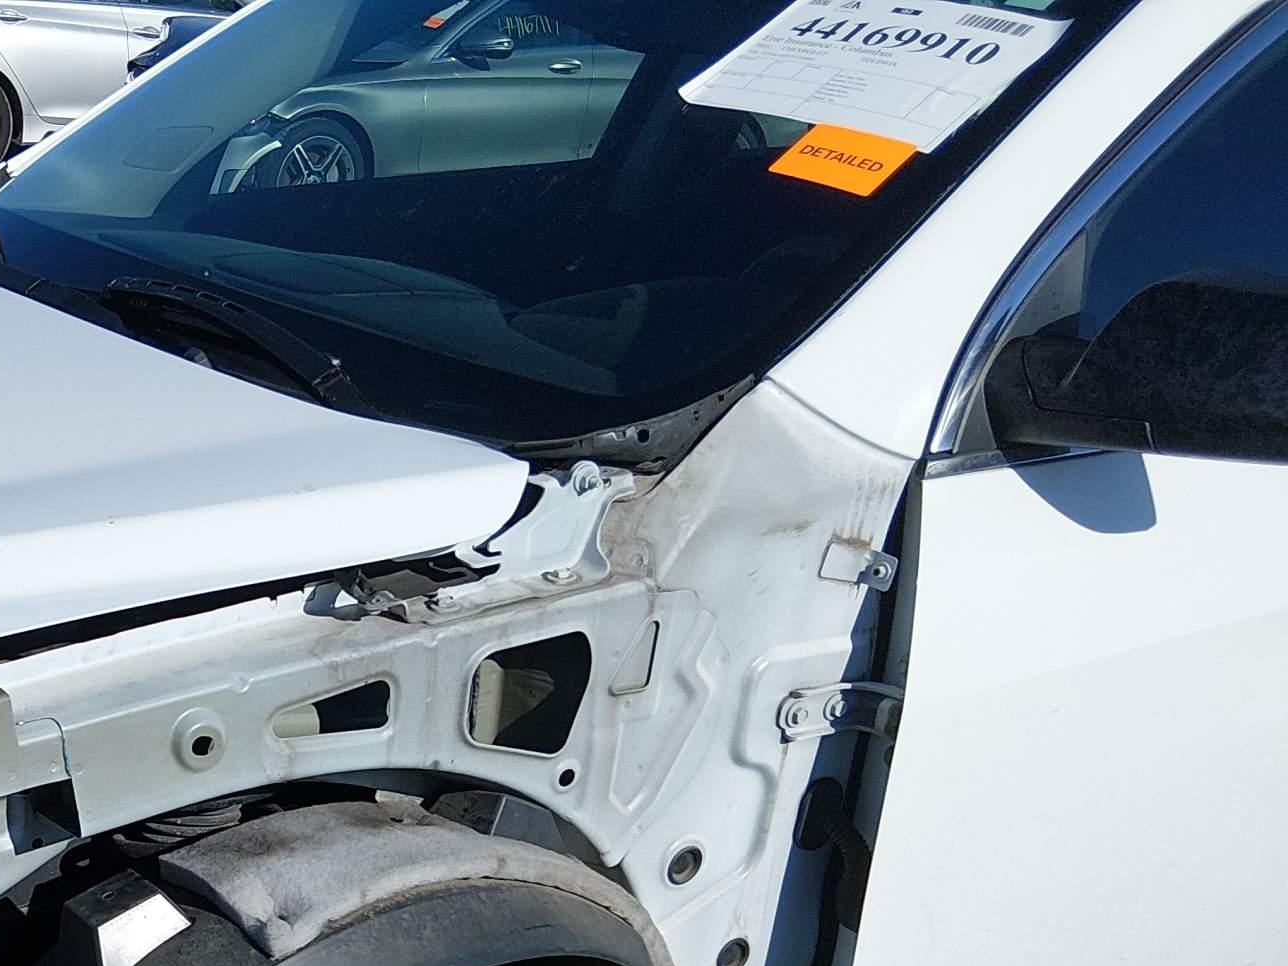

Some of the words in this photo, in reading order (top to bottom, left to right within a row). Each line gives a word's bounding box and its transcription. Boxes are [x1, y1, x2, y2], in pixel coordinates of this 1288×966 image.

[785, 36, 832, 49] Insurance
[840, 44, 893, 57] Columbus
[791, 16, 1001, 65] 44169910
[798, 144, 884, 173] DETAILED
